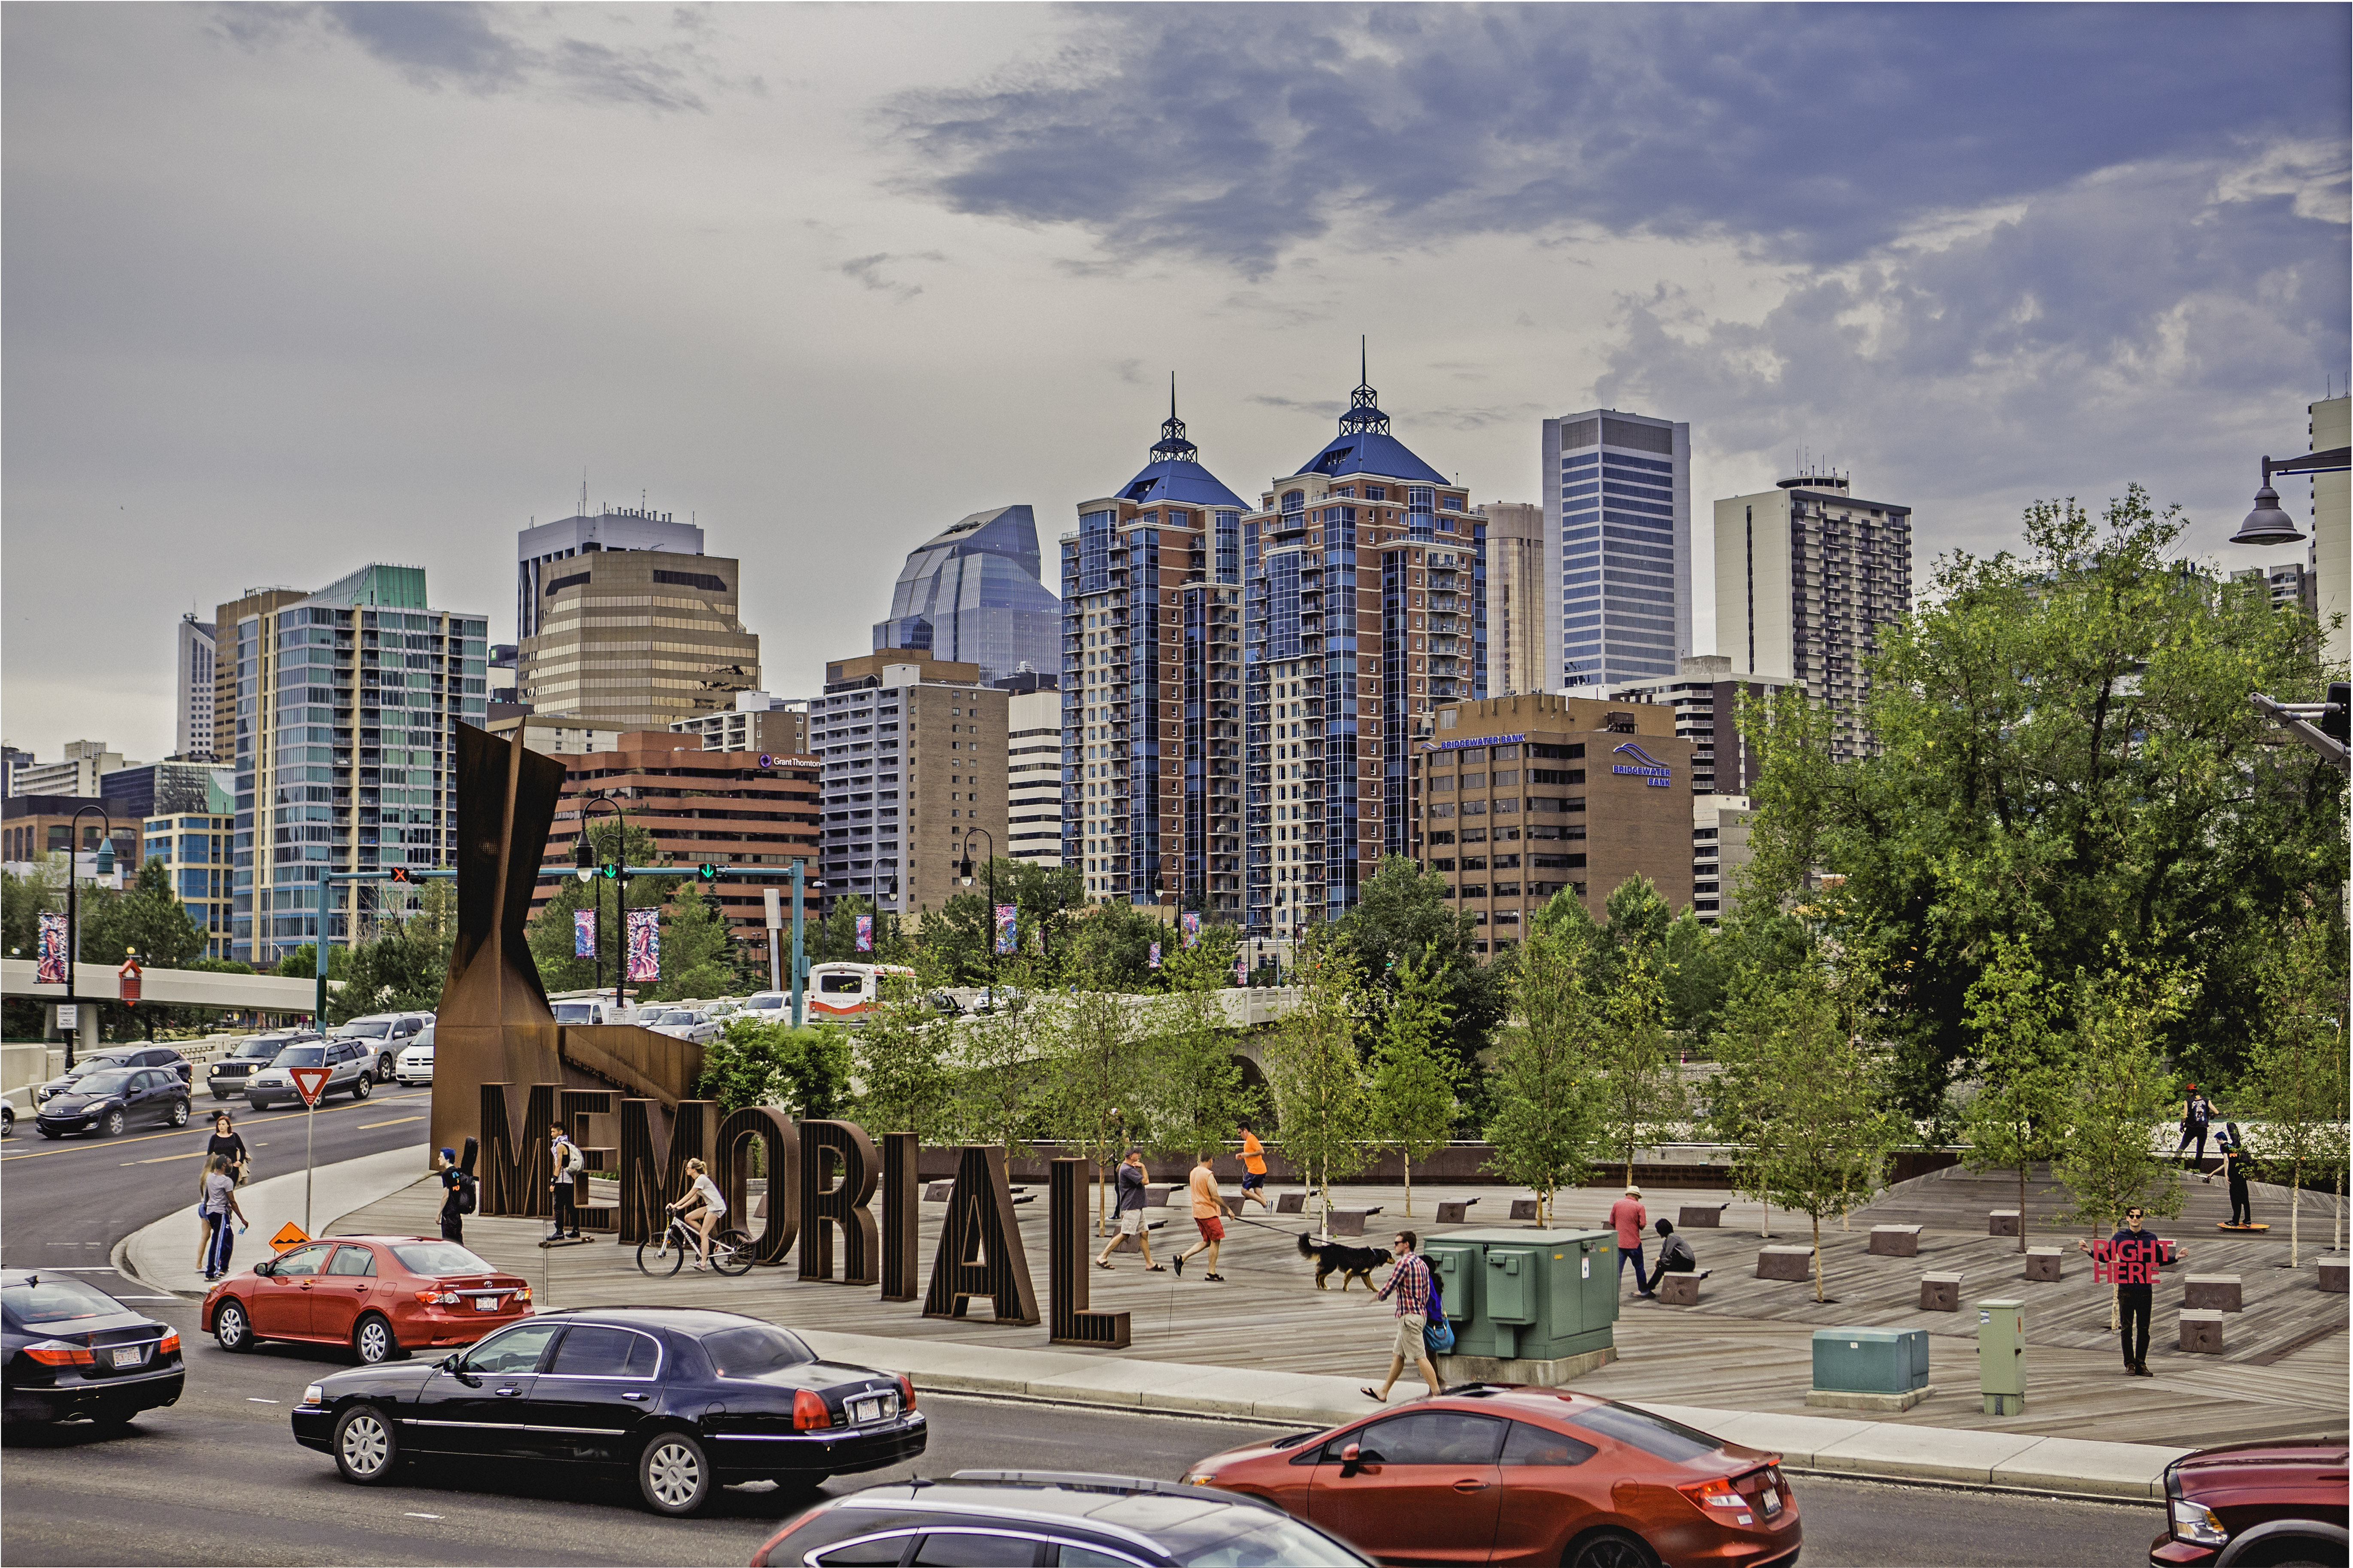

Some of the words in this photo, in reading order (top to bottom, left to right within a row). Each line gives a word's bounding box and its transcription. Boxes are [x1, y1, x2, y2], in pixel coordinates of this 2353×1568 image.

[1441, 736, 1500, 750] BRIDGEWATER
[1501, 734, 1525, 743] BANK
[773, 757, 792, 766] Grant
[792, 758, 820, 767] Thornton
[1613, 765, 1671, 776] BRIDGEWATER
[1647, 777, 1671, 787] BANK
[479, 1082, 1131, 1349] MEMORIAL
[2093, 1240, 2174, 1262] RIGHT
[2093, 1262, 2161, 1284] HERE
